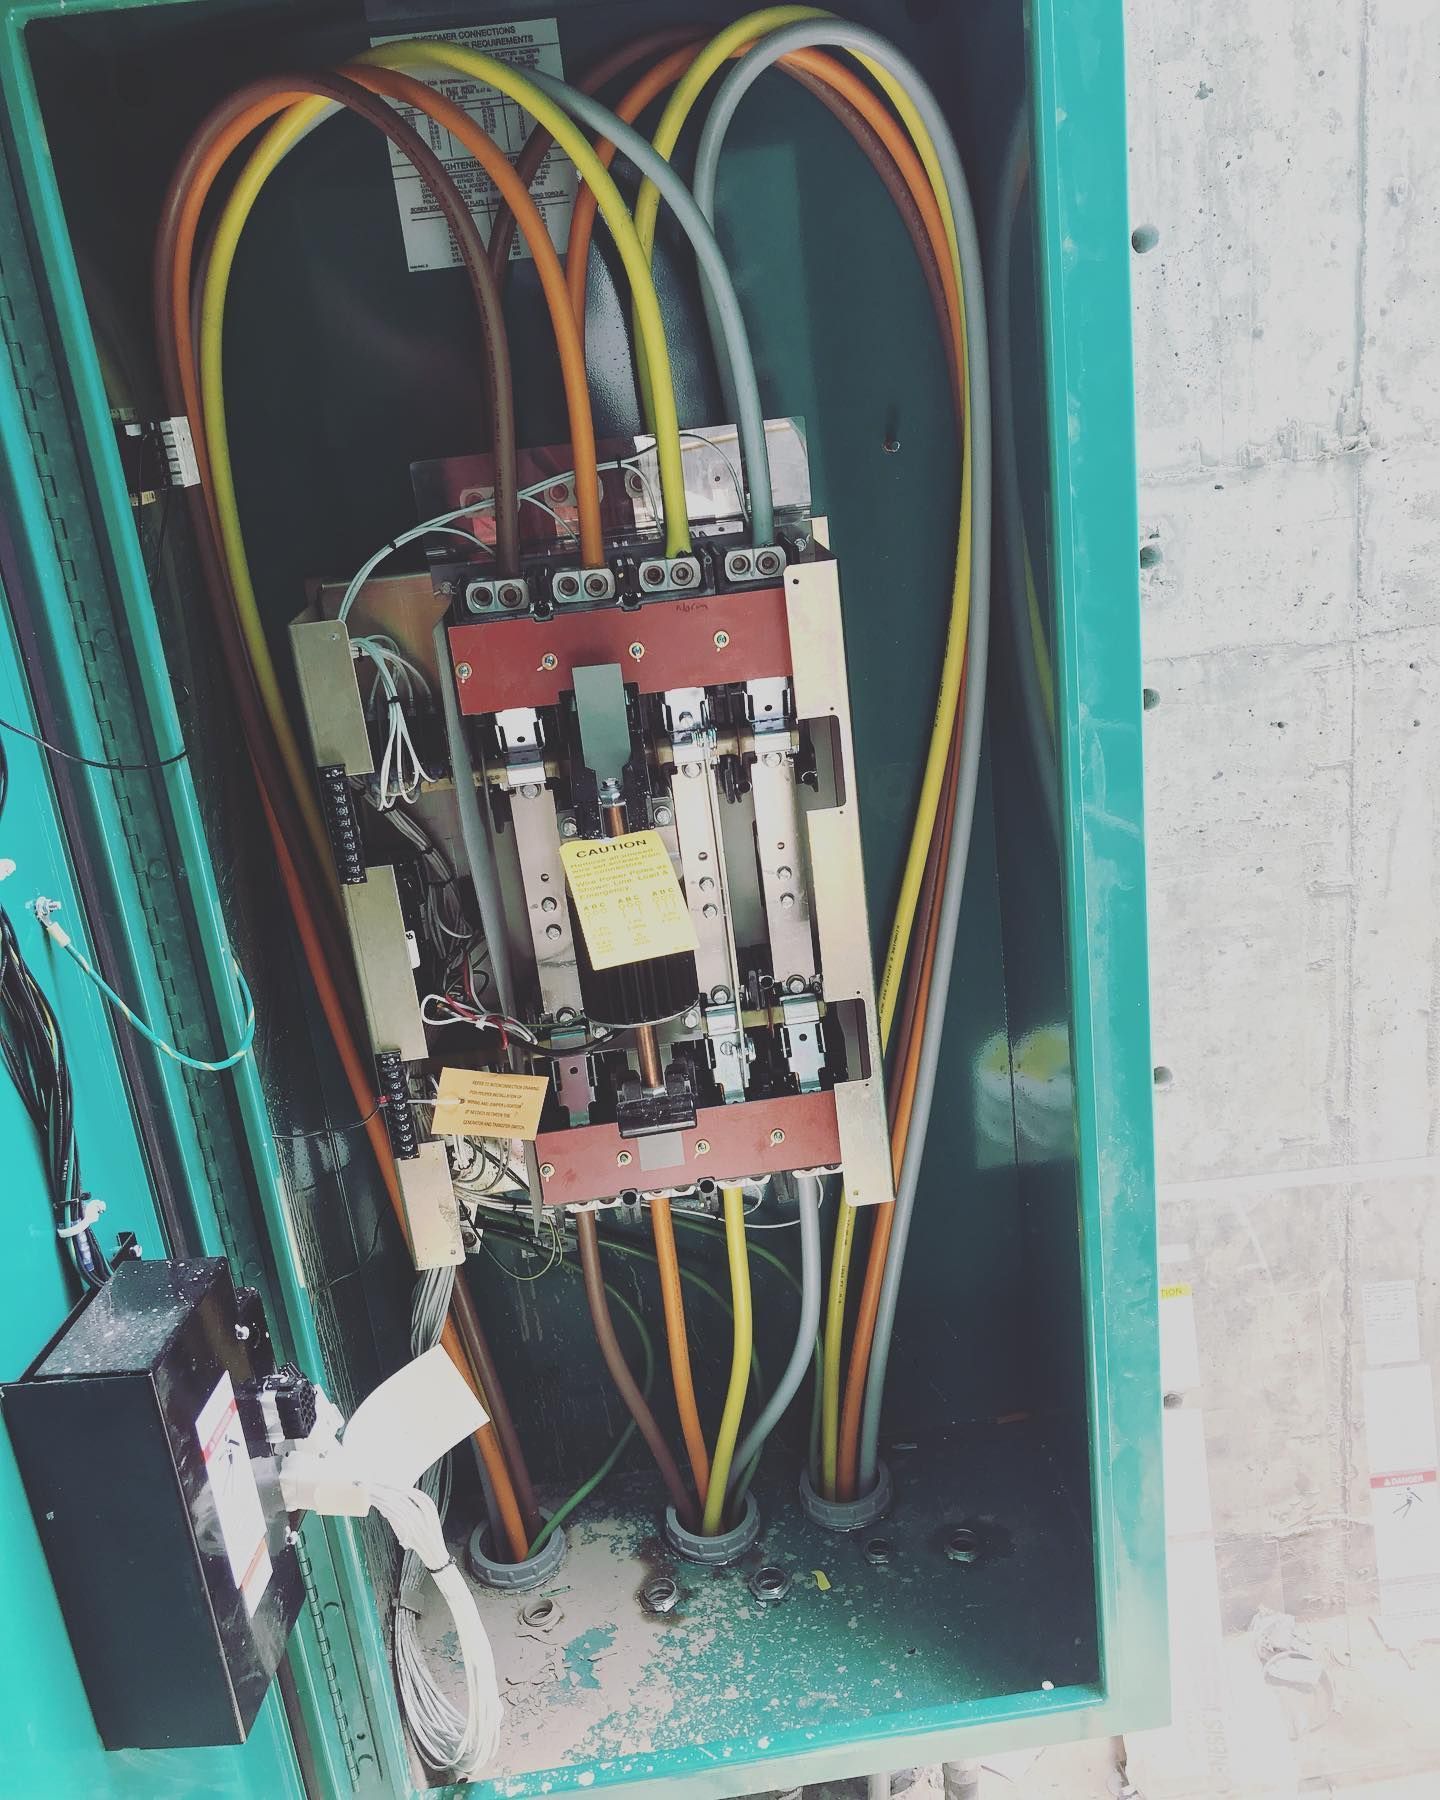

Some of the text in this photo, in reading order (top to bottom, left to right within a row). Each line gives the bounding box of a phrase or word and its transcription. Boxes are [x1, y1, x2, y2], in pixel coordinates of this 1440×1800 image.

[459, 26, 516, 39] CONNECTIONS
[472, 35, 534, 48] REQUIREMENTS
[576, 839, 648, 859] CAUTION
